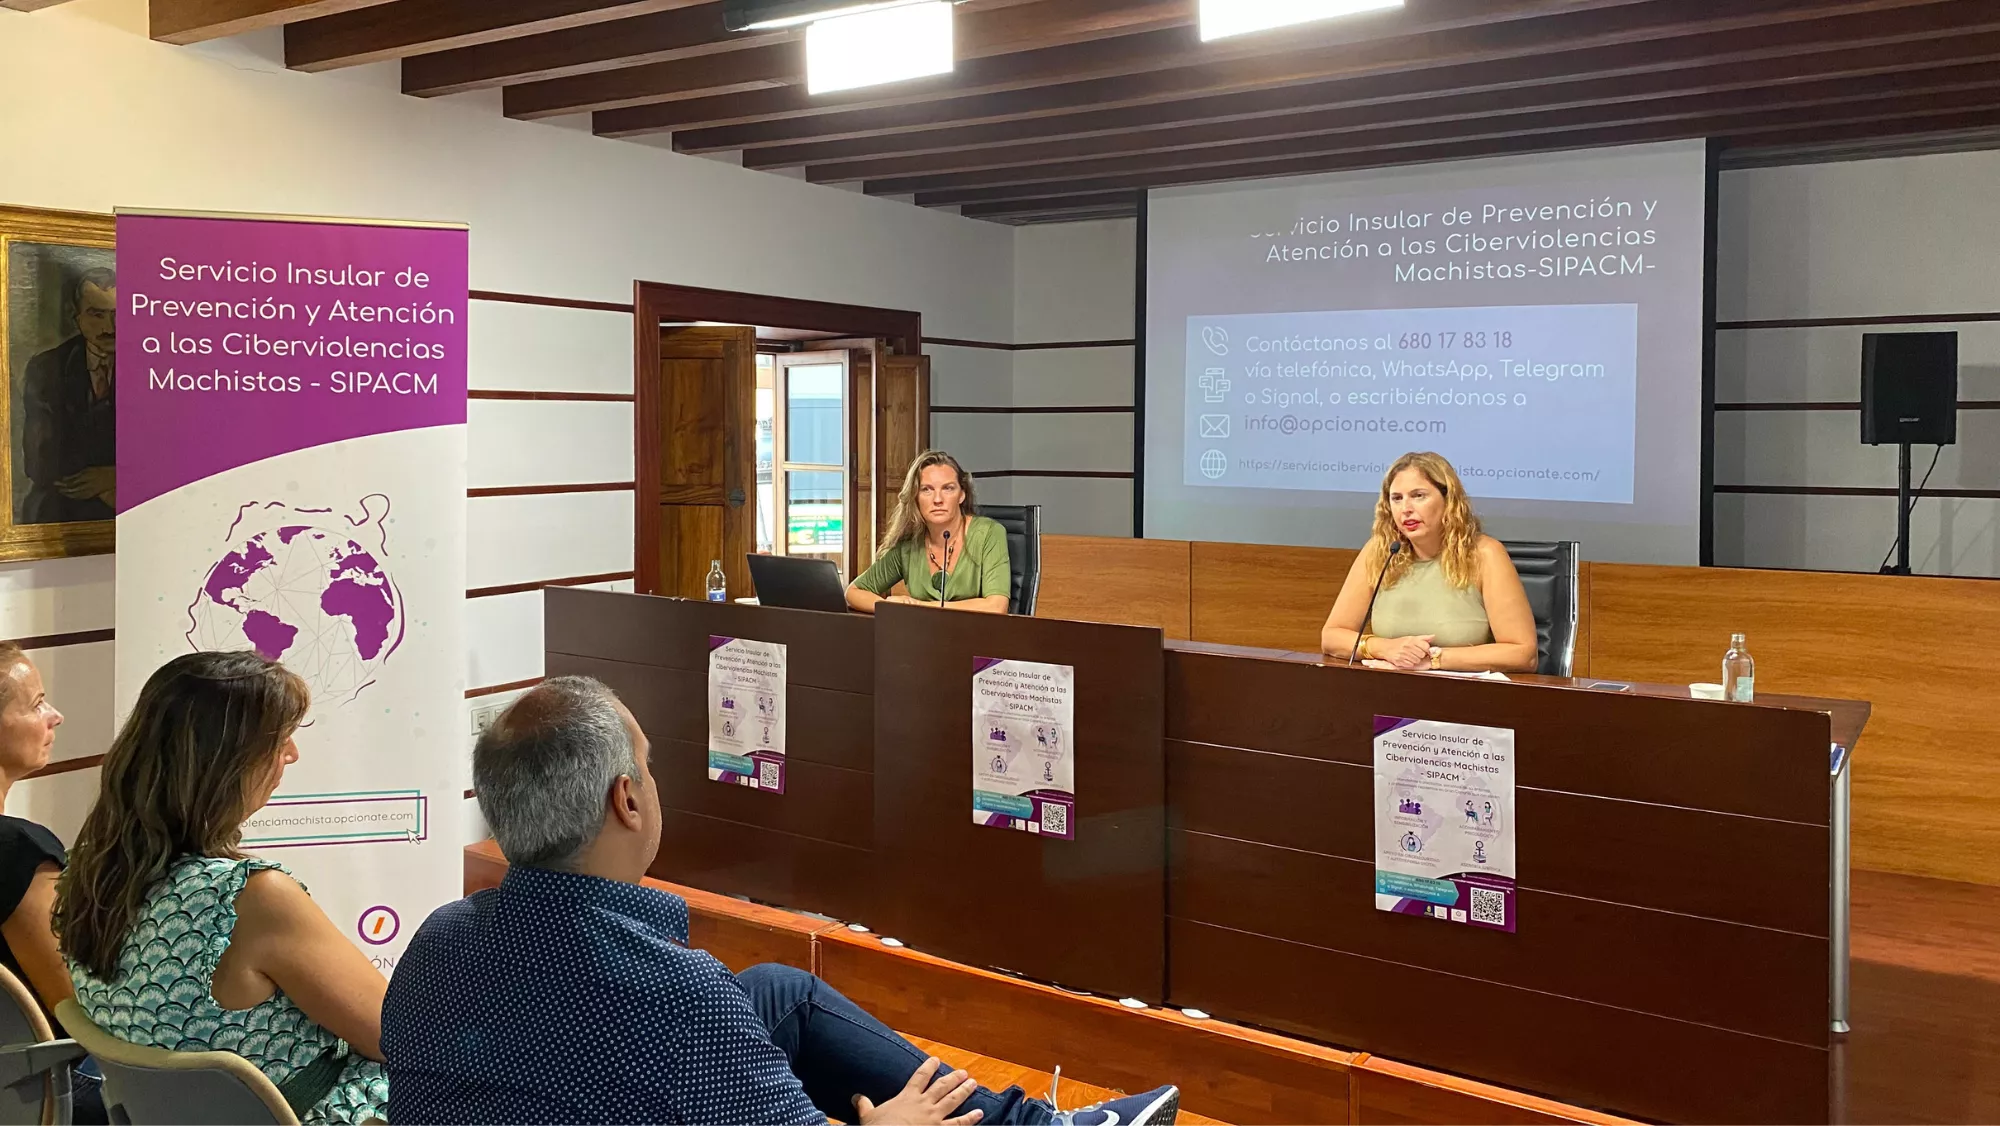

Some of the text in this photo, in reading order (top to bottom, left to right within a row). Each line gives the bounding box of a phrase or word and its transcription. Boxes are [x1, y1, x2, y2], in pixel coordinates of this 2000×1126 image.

[1250, 196, 1658, 238] vicio Insular de Prevención y
[1265, 226, 1656, 263] Atención a las Ciberviolencias
[159, 257, 430, 289] Servicio Insular de
[131, 293, 455, 327] Prevención y Atención
[142, 332, 446, 360] a las Ciberviolencias
[1246, 331, 1513, 352] Contáctanos al 680 17 83 18
[1244, 358, 1605, 382] vía telefónica, WhatsApp, Telegram
[149, 368, 301, 393] Machistas
[330, 371, 438, 395] SIPACM
[1244, 386, 1527, 409] o Signal, o escribiéndonos a
[1244, 414, 1447, 435] info@opcionate.com
[978, 677, 1013, 687] Prevención
[1020, 683, 1049, 692] Atención
[992, 668, 1018, 678] Servicio
[1018, 671, 1041, 680] Insular
[981, 688, 1063, 704] Ciberviolencias Machistas
[1009, 703, 1034, 711] SIPACM
[1402, 729, 1484, 746] Servicio Insular de
[1382, 740, 1431, 753] Prevención
[1433, 747, 1439, 755] y
[1441, 747, 1481, 759] Atención
[1491, 753, 1505, 762] las
[1385, 753, 1500, 774] Ciberviolencias Machistas
[1426, 770, 1460, 782] SIPACM
[242, 812, 414, 828] olenciamachista.opcionate.com
